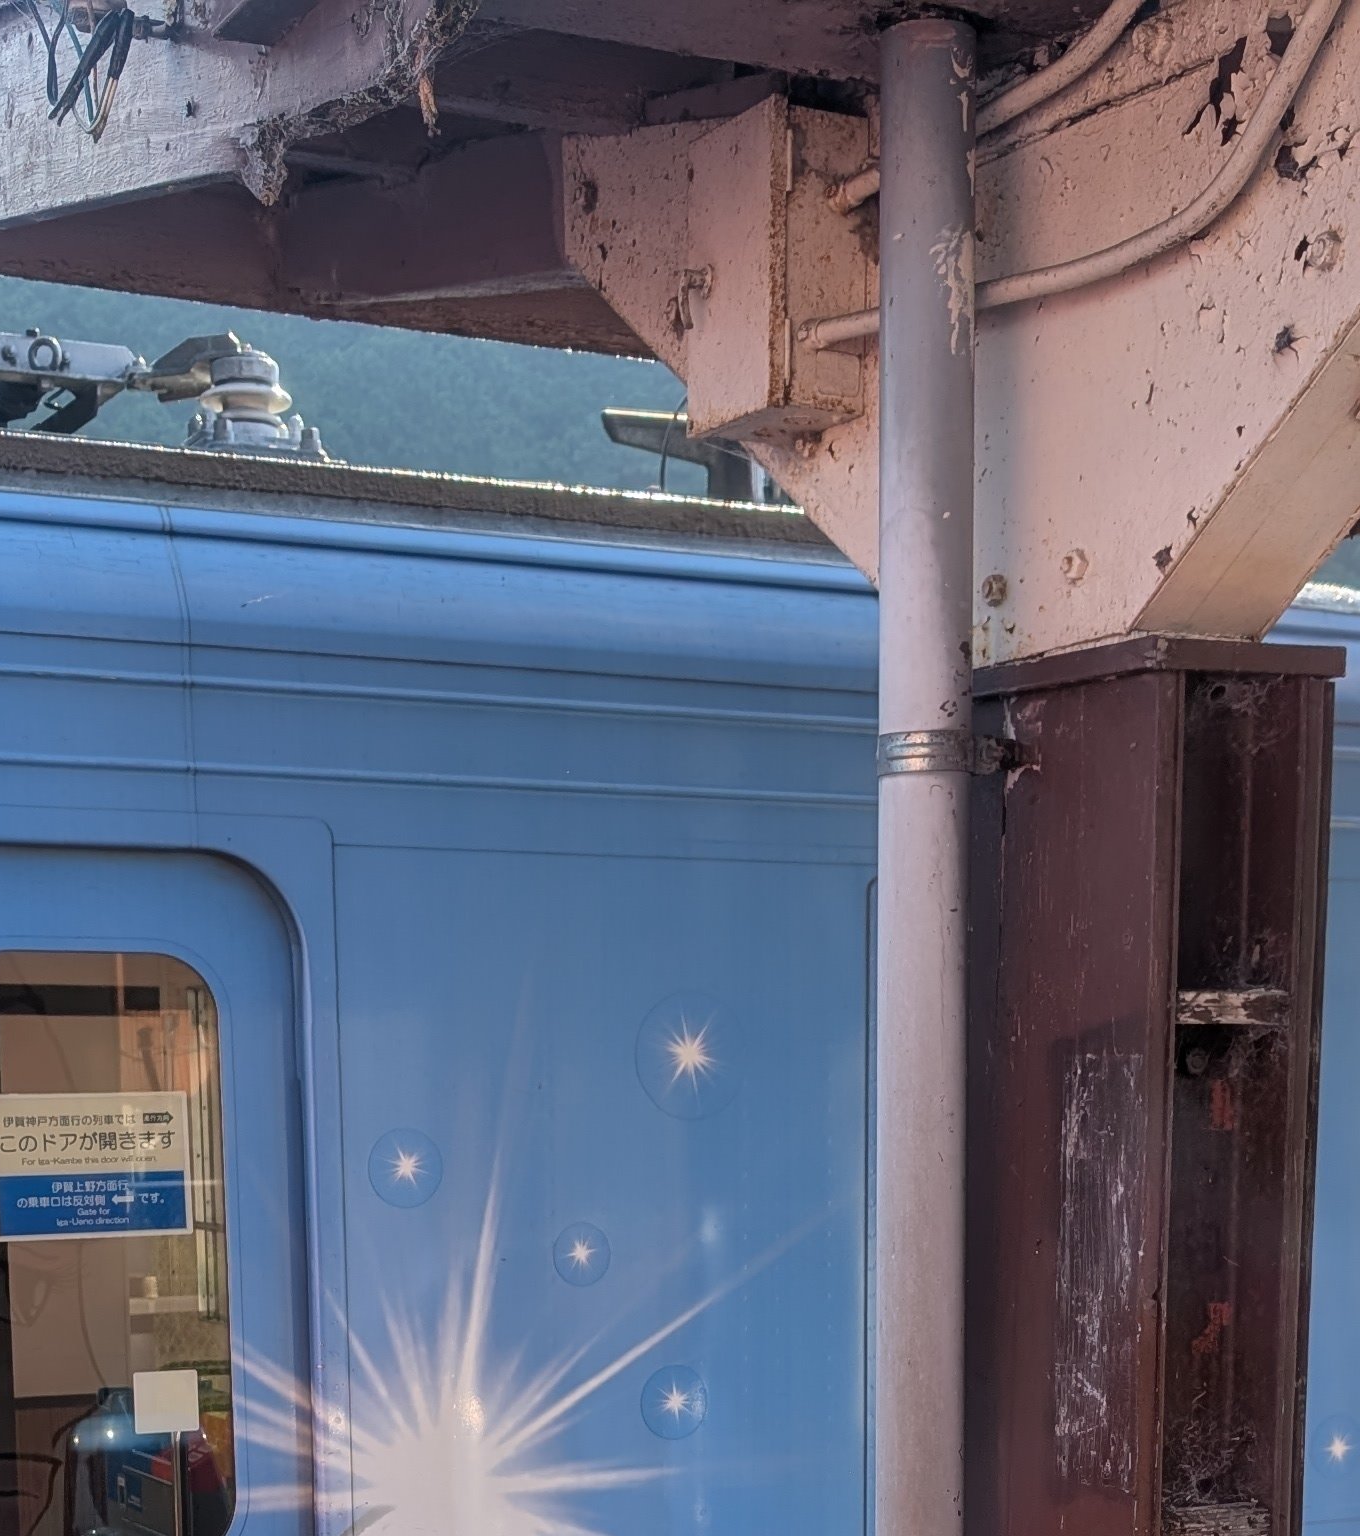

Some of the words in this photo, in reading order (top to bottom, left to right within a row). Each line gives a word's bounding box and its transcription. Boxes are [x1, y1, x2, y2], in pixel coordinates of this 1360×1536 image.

[2, 1113, 136, 1128] 伊賀神戸方面行の列車では
[0, 1130, 176, 1153] このドアが開きます
[21, 1157, 36, 1166] For
[84, 1156, 99, 1164] this
[100, 1155, 119, 1164] door
[51, 1179, 129, 1194] 伊賀上野方面行
[16, 1194, 107, 1209] の乗車口は反対側
[138, 1192, 165, 1205] です。
[77, 1207, 97, 1216] Gate
[98, 1206, 111, 1215] for
[95, 1216, 130, 1226] direction
